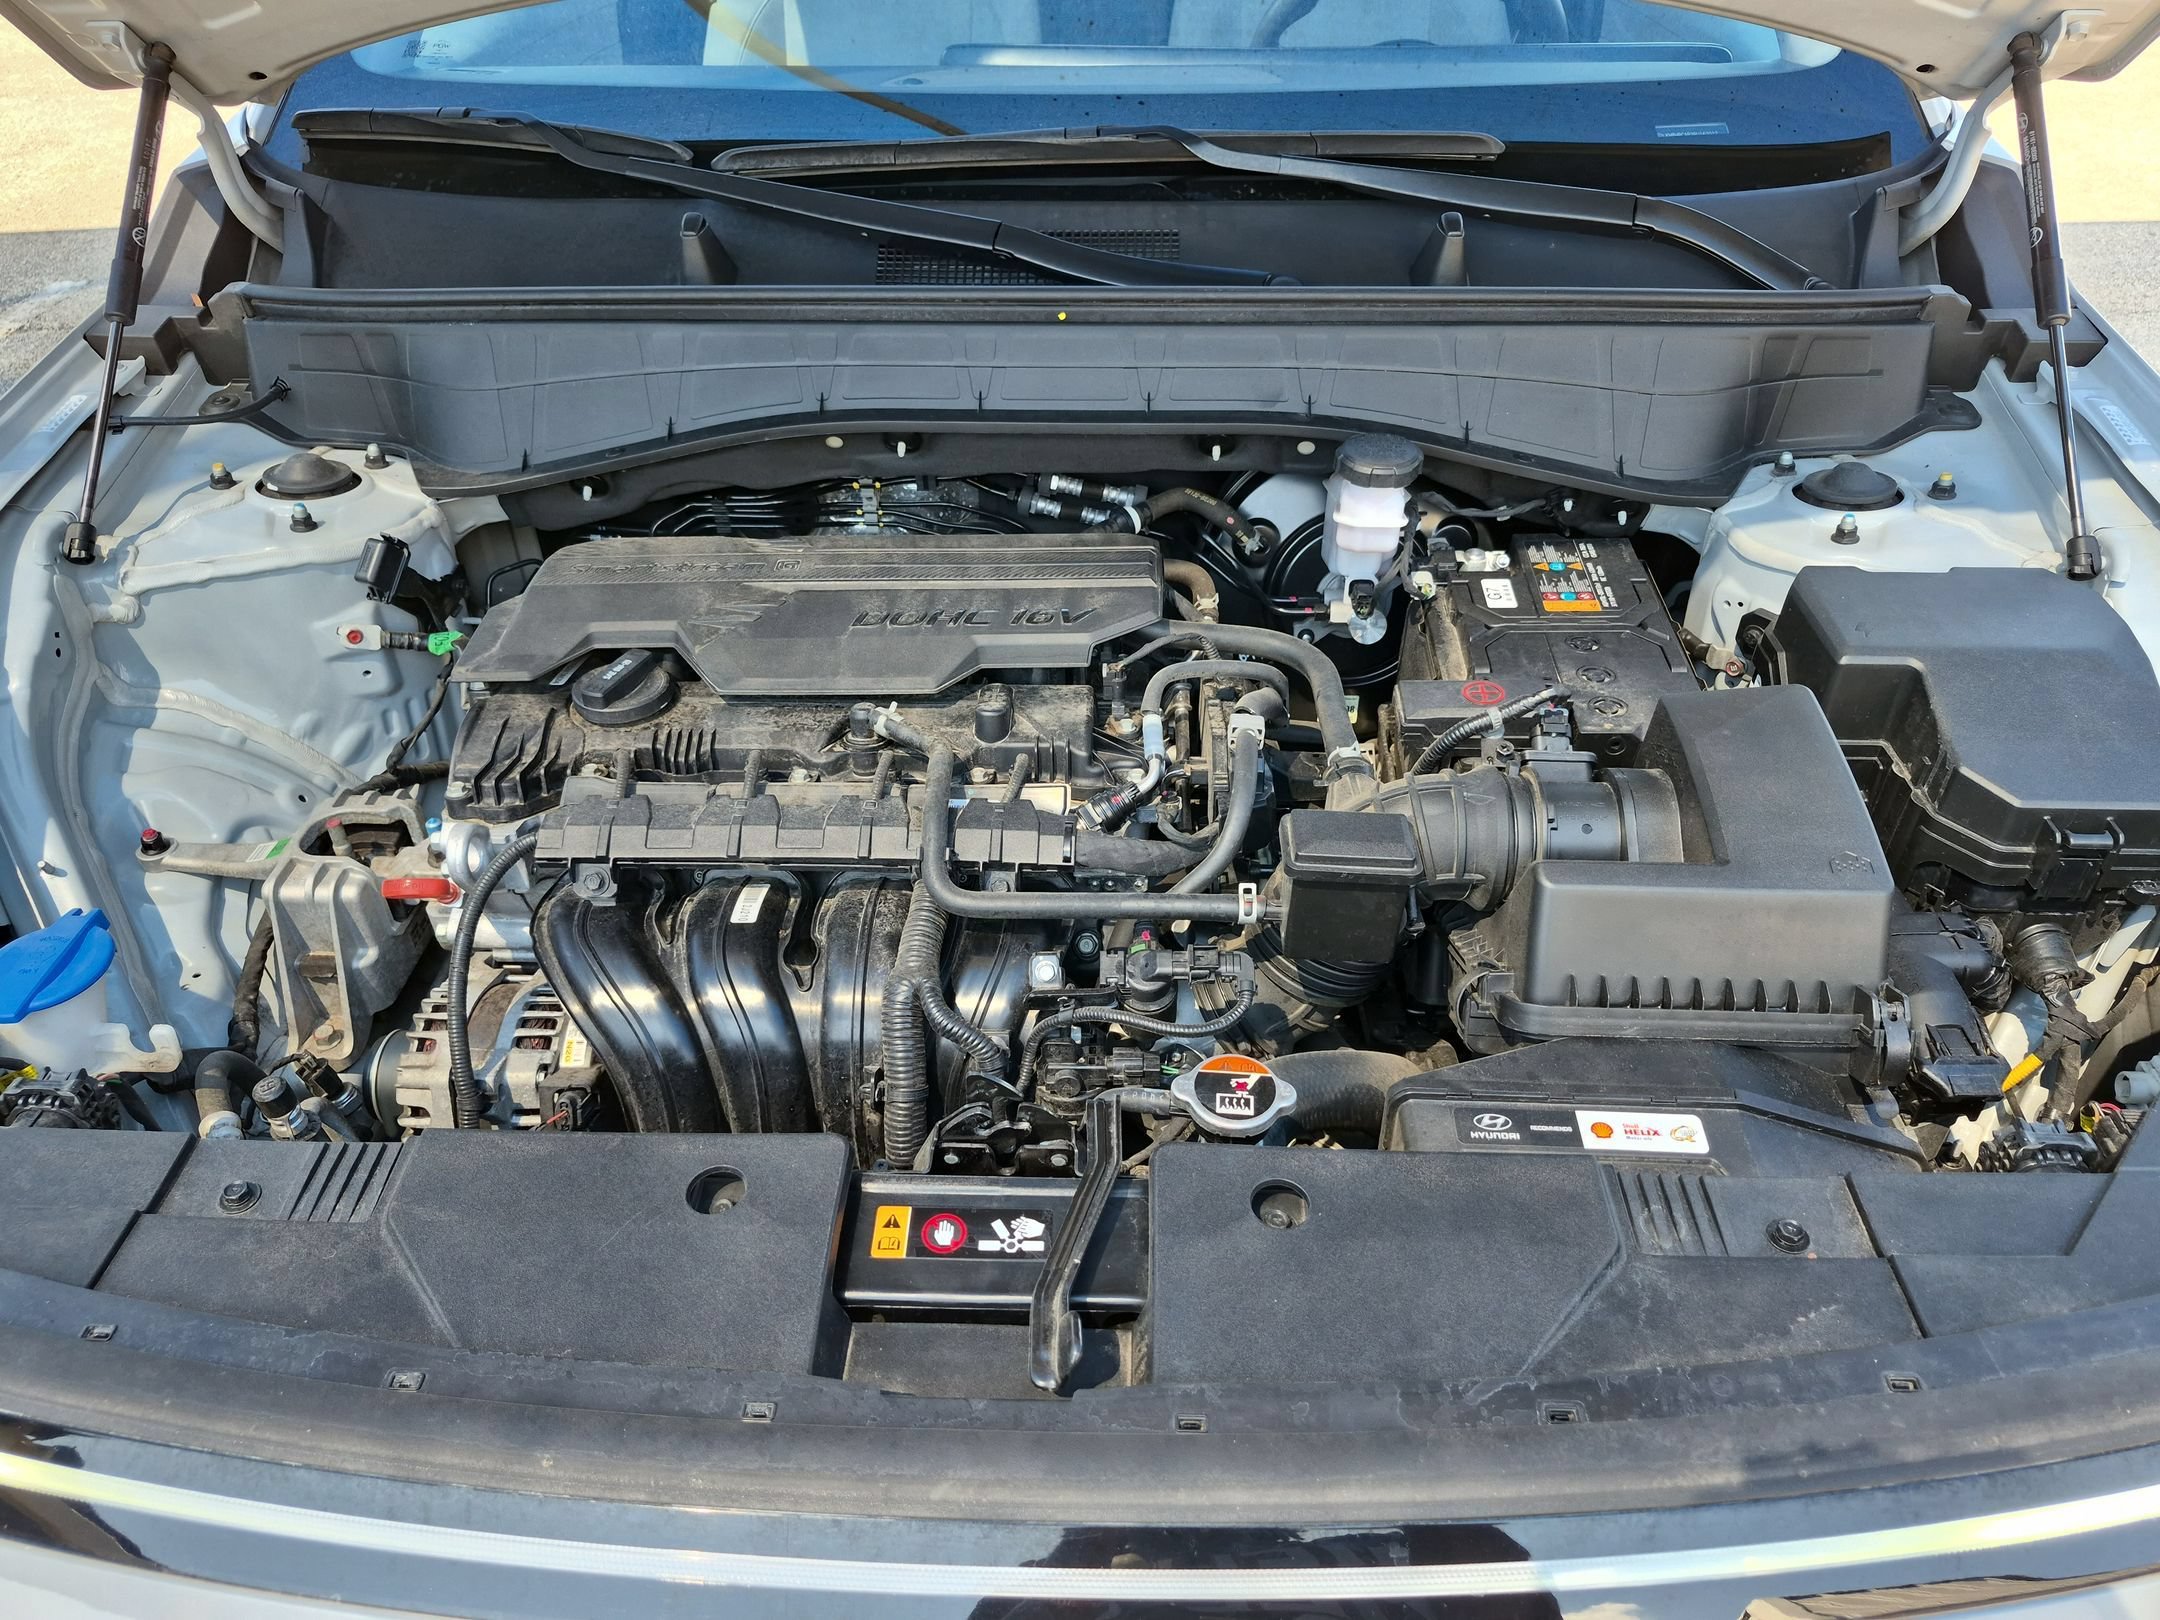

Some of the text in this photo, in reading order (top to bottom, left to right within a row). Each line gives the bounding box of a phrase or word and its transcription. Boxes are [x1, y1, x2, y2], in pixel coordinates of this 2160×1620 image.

[850, 607, 1098, 628] DOHC 16V
[1470, 1130, 1521, 1140] HYUNDAI
[1624, 1128, 1662, 1137] HELIX
